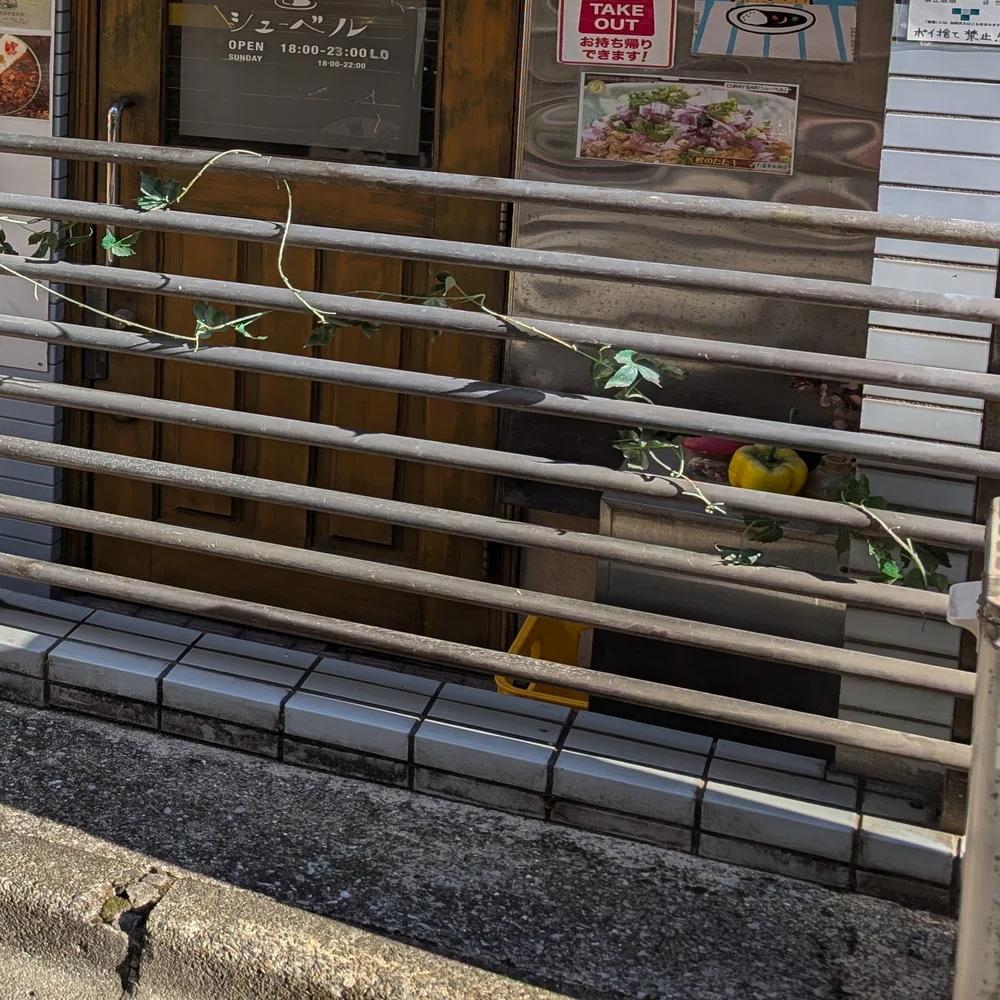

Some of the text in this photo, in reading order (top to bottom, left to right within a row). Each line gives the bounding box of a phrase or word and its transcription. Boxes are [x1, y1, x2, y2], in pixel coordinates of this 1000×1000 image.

[589, 2, 644, 17] TAKE
[230, 10, 368, 38] シューベル
[594, 17, 640, 31] OUT
[228, 39, 265, 52] OPEN
[280, 42, 367, 59] 18:00-23:00
[579, 36, 653, 50] お持ち帰り
[228, 53, 263, 63] SUNDAY
[582, 49, 649, 63] できます!
